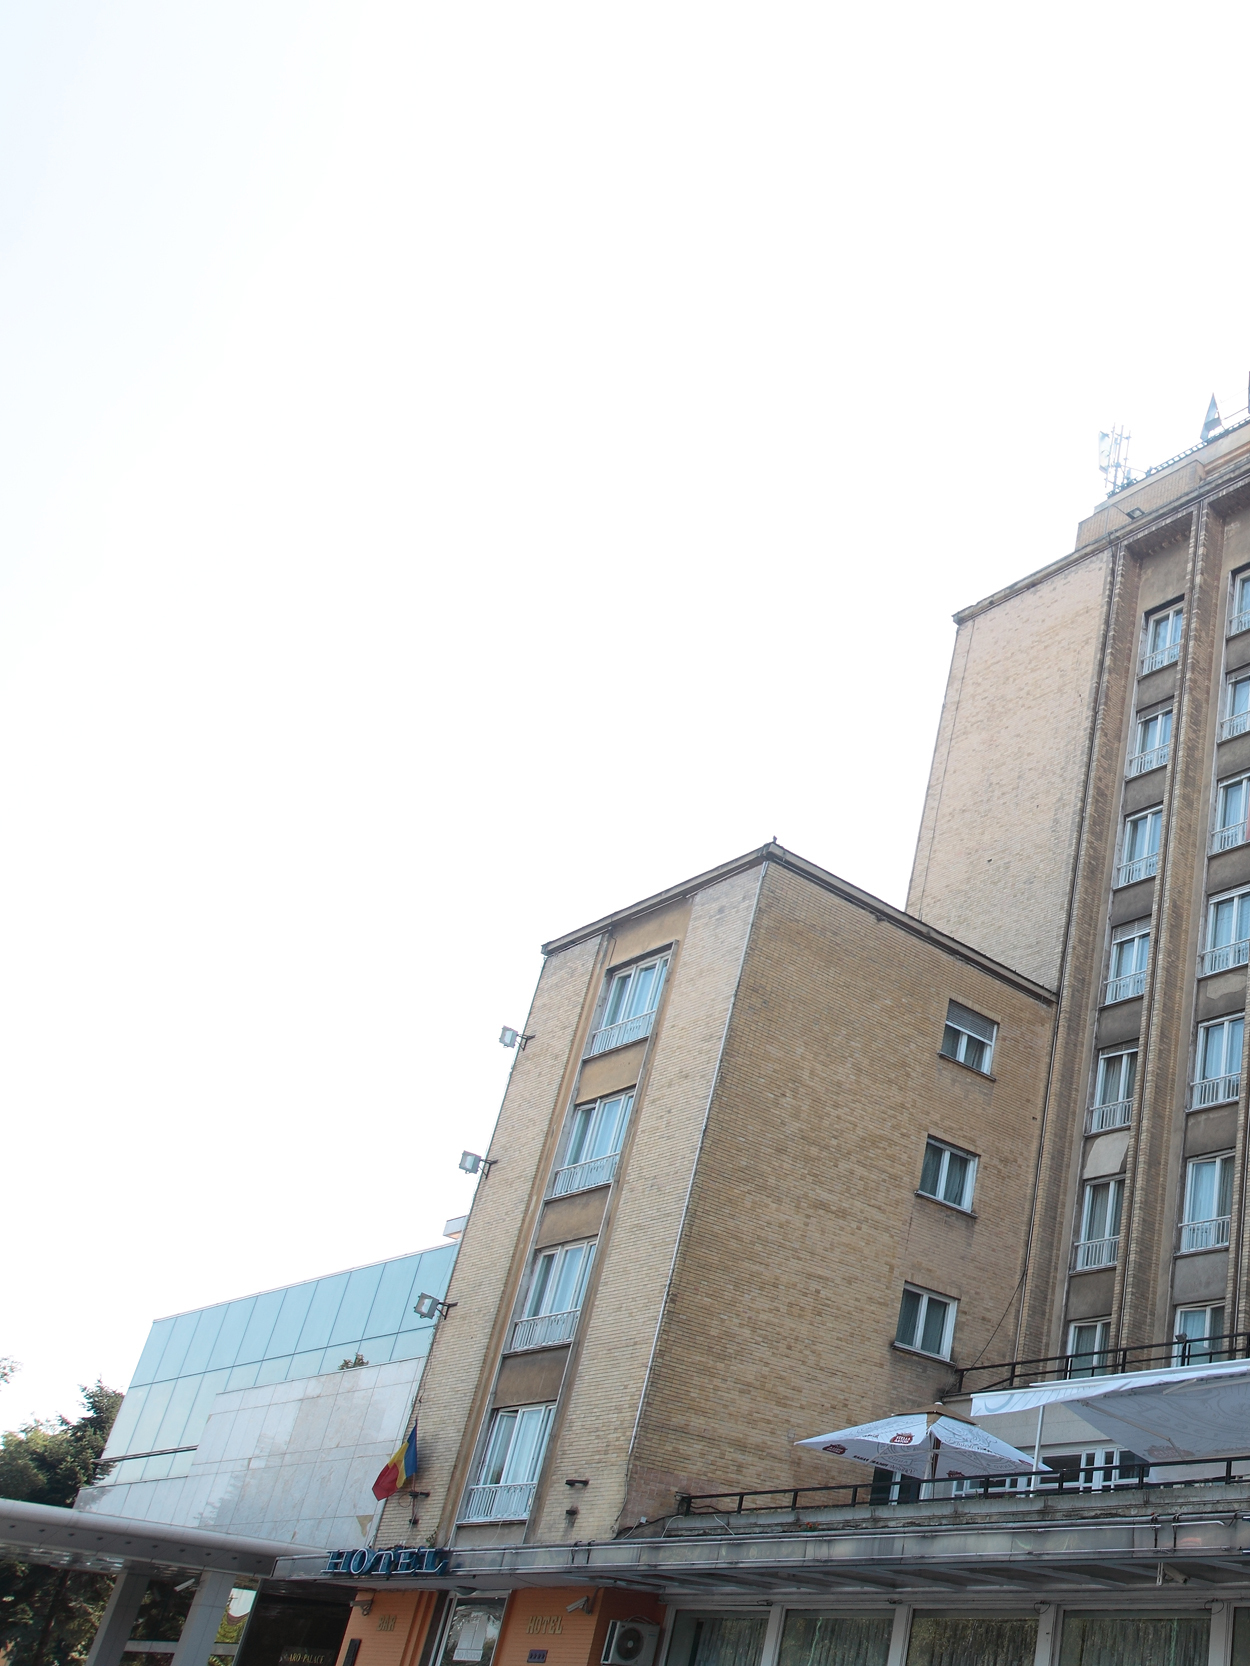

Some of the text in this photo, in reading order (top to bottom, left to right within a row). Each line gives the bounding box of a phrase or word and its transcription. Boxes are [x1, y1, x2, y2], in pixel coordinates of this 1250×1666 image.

[320, 1547, 449, 1577] HOTEL
[376, 1614, 397, 1631] BAR
[526, 1616, 563, 1635] HOTEL
